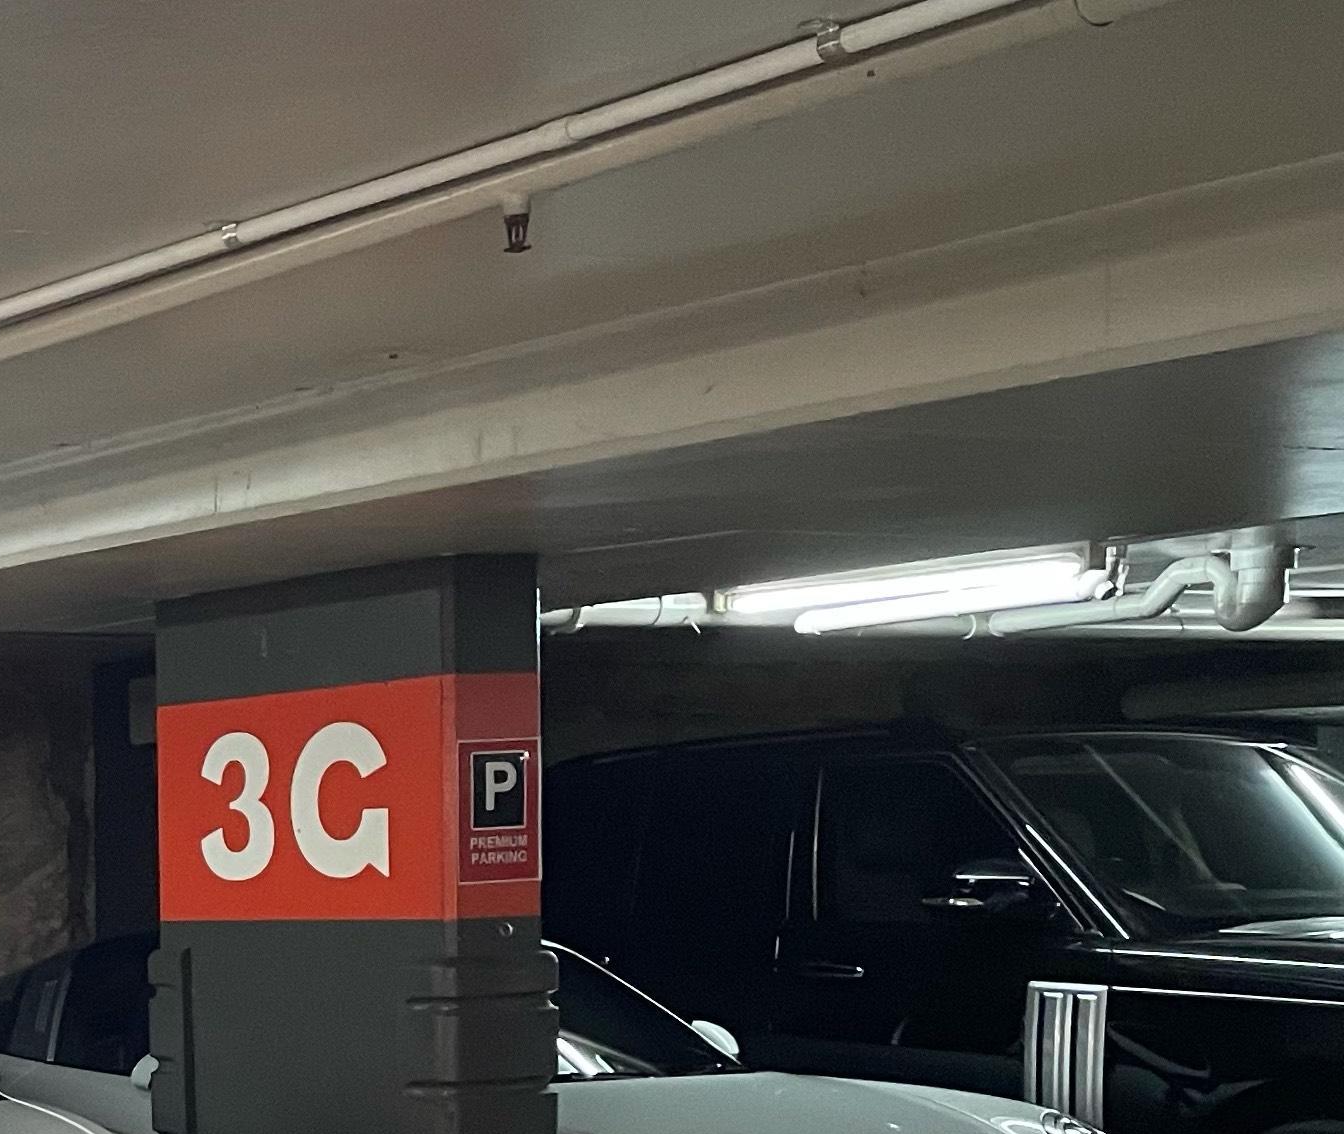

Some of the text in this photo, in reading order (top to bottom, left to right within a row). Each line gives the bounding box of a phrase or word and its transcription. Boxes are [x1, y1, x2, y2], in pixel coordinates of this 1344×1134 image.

[201, 721, 390, 882] 3G
[485, 761, 518, 811] P
[470, 835, 528, 850] PREMIUM
[472, 850, 528, 865] PARKING
